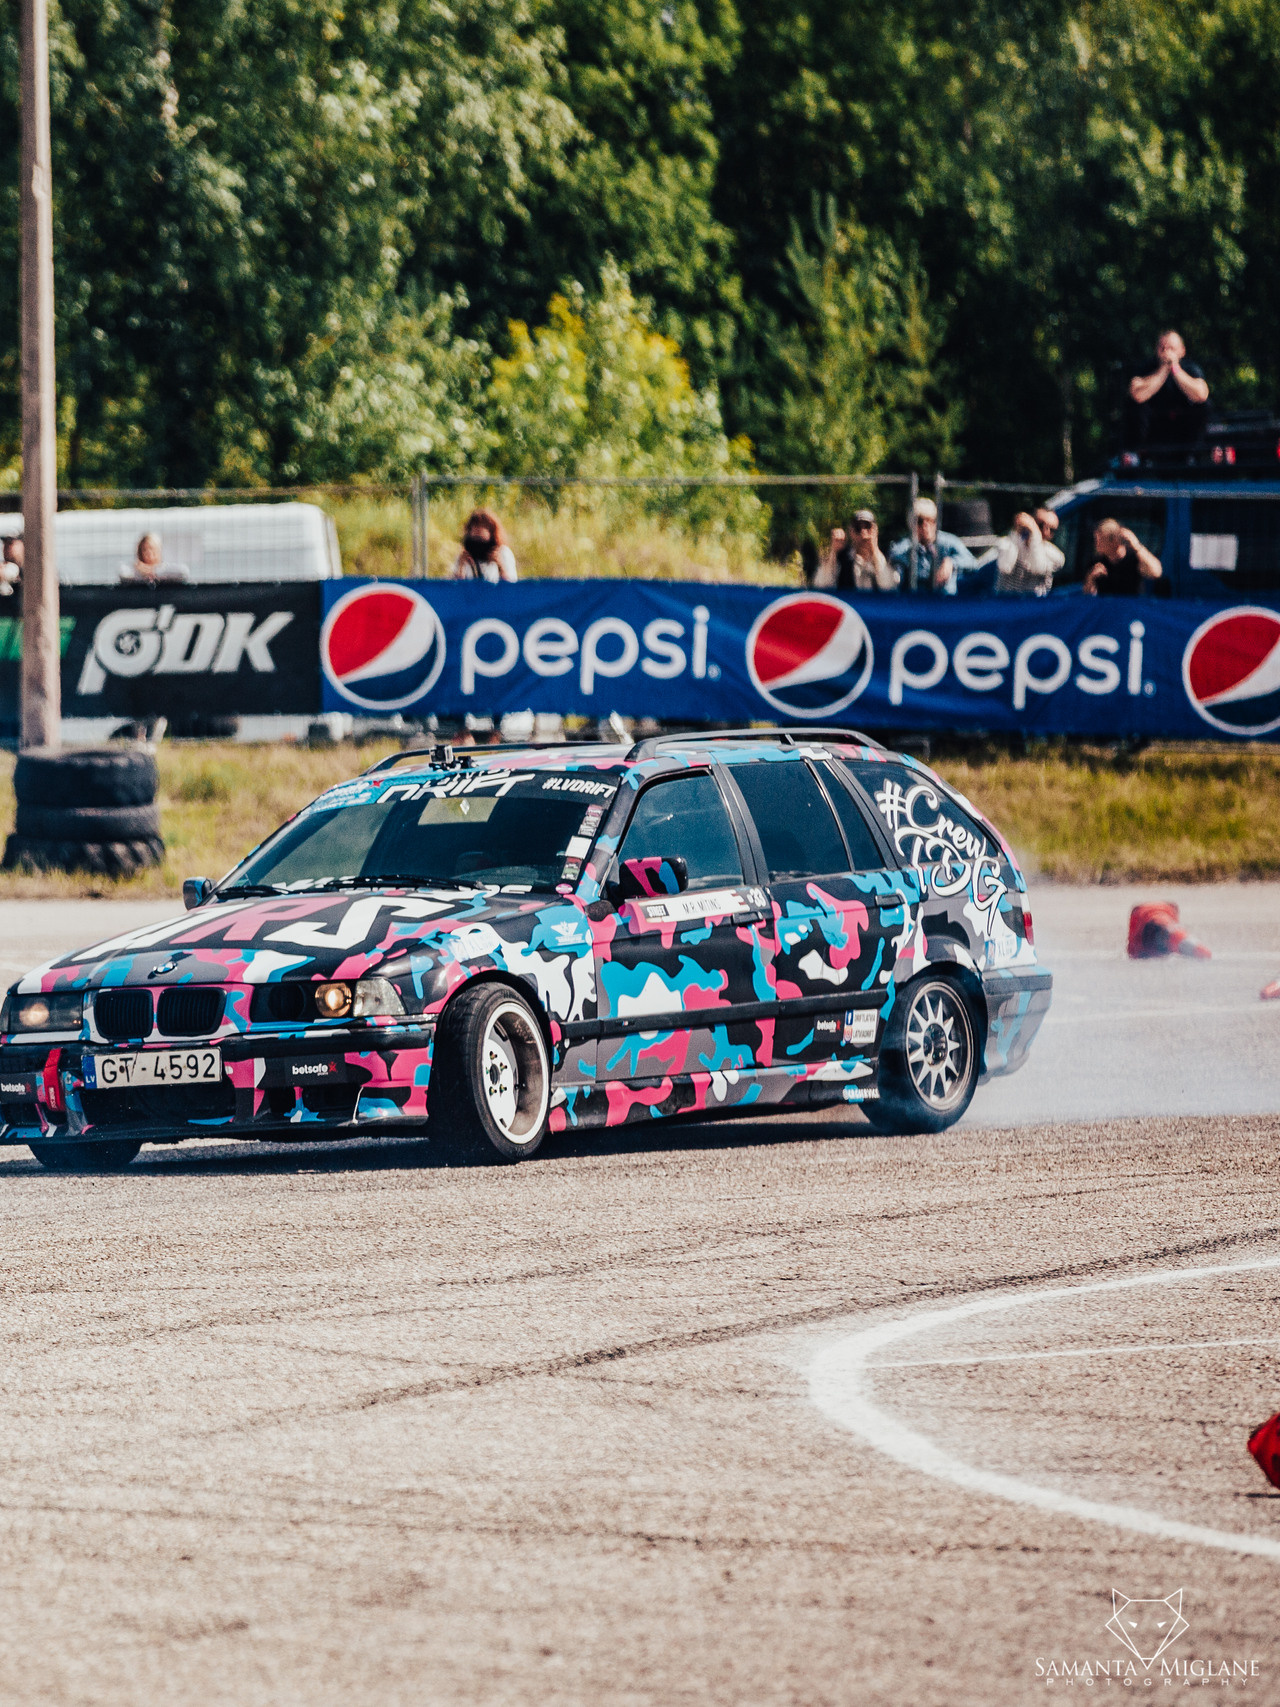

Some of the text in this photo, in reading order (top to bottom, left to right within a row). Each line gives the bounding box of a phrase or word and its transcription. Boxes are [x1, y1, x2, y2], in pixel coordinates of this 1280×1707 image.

[460, 604, 710, 697] pepsi
[888, 621, 1144, 711] pepsi
[542, 777, 617, 799] #LVDRIFT
[85, 1075, 96, 1084] LV
